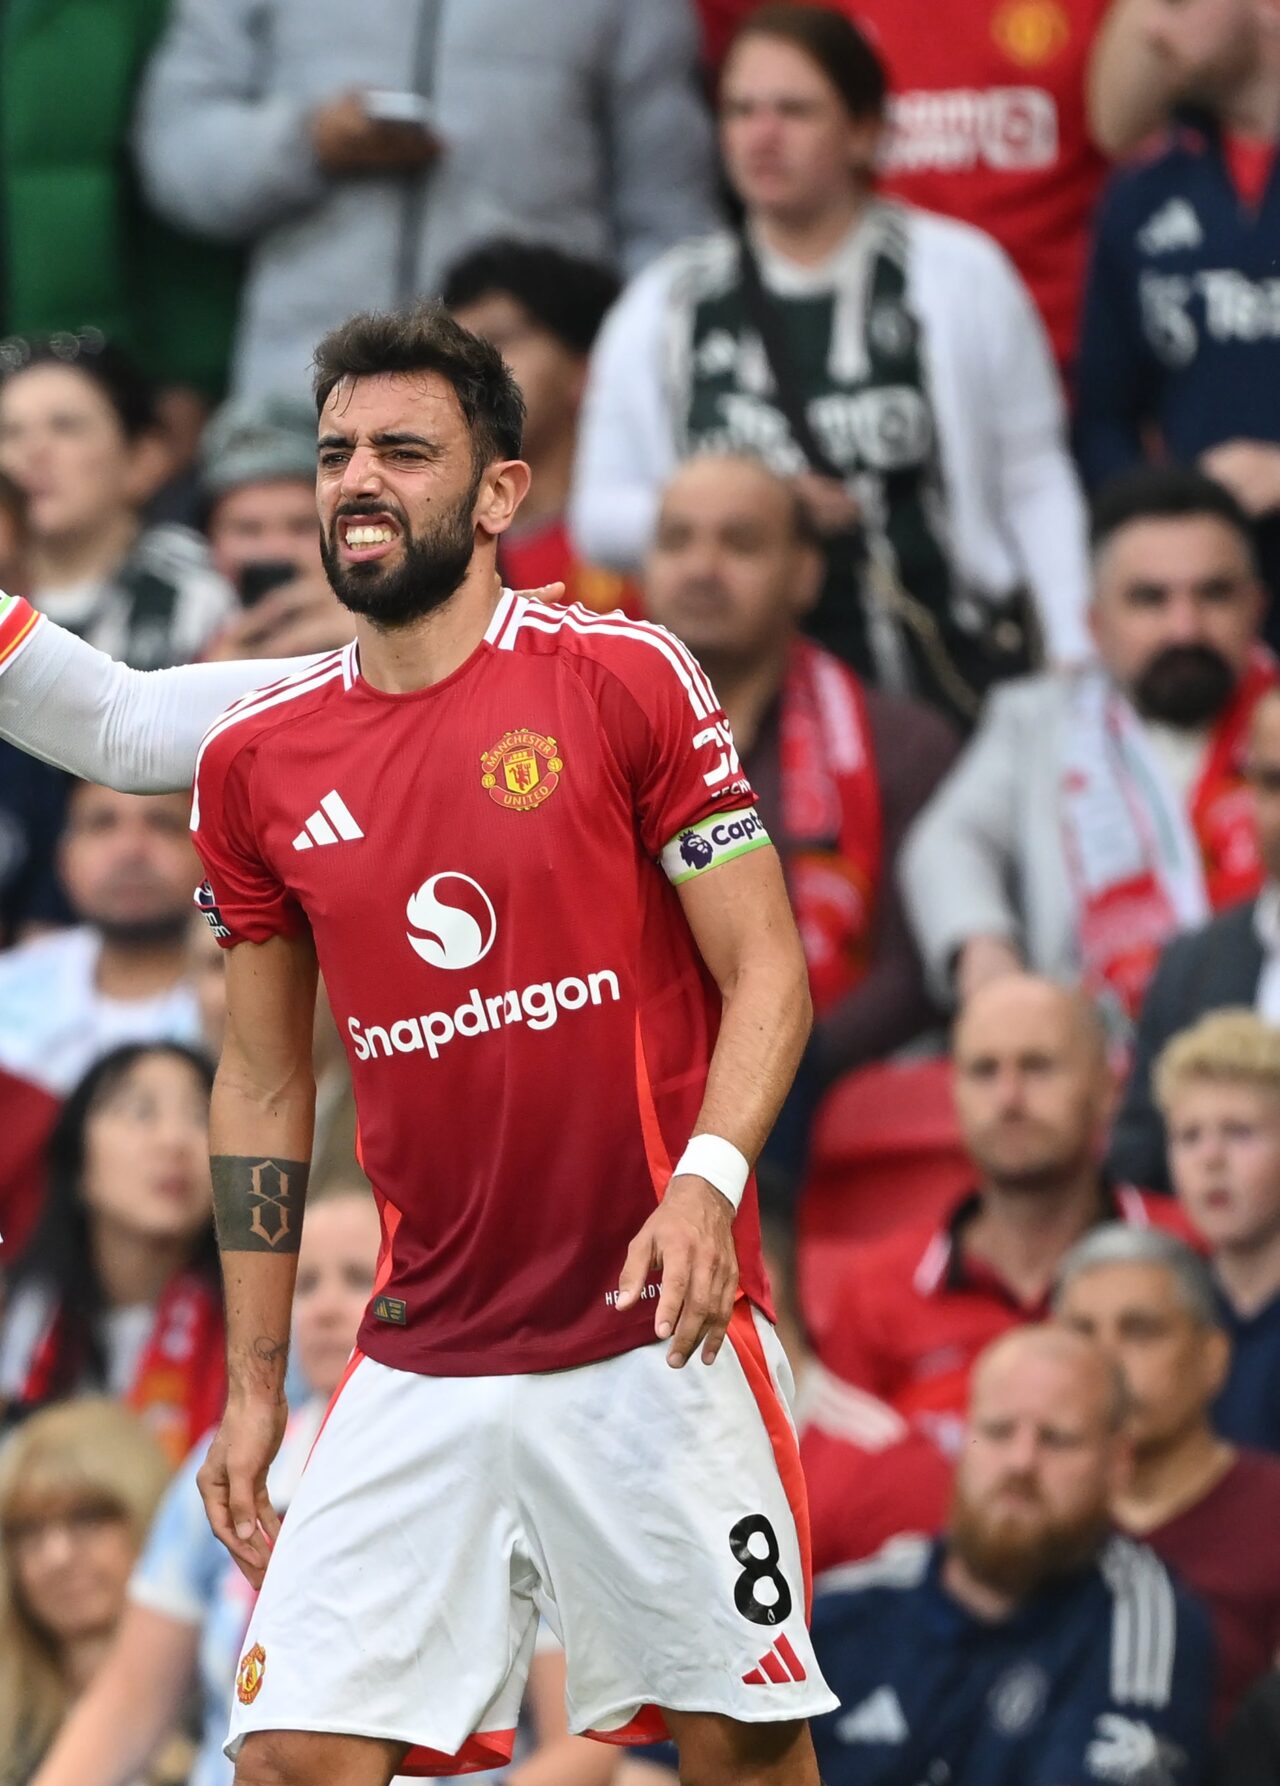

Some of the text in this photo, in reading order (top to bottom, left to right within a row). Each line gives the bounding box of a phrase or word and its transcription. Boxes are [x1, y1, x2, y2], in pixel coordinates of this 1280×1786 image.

[486, 734, 551, 767] MANCHESTER
[503, 785, 549, 805] UNITED
[348, 969, 621, 1060] Snapdragon
[729, 1513, 792, 1626] 8
